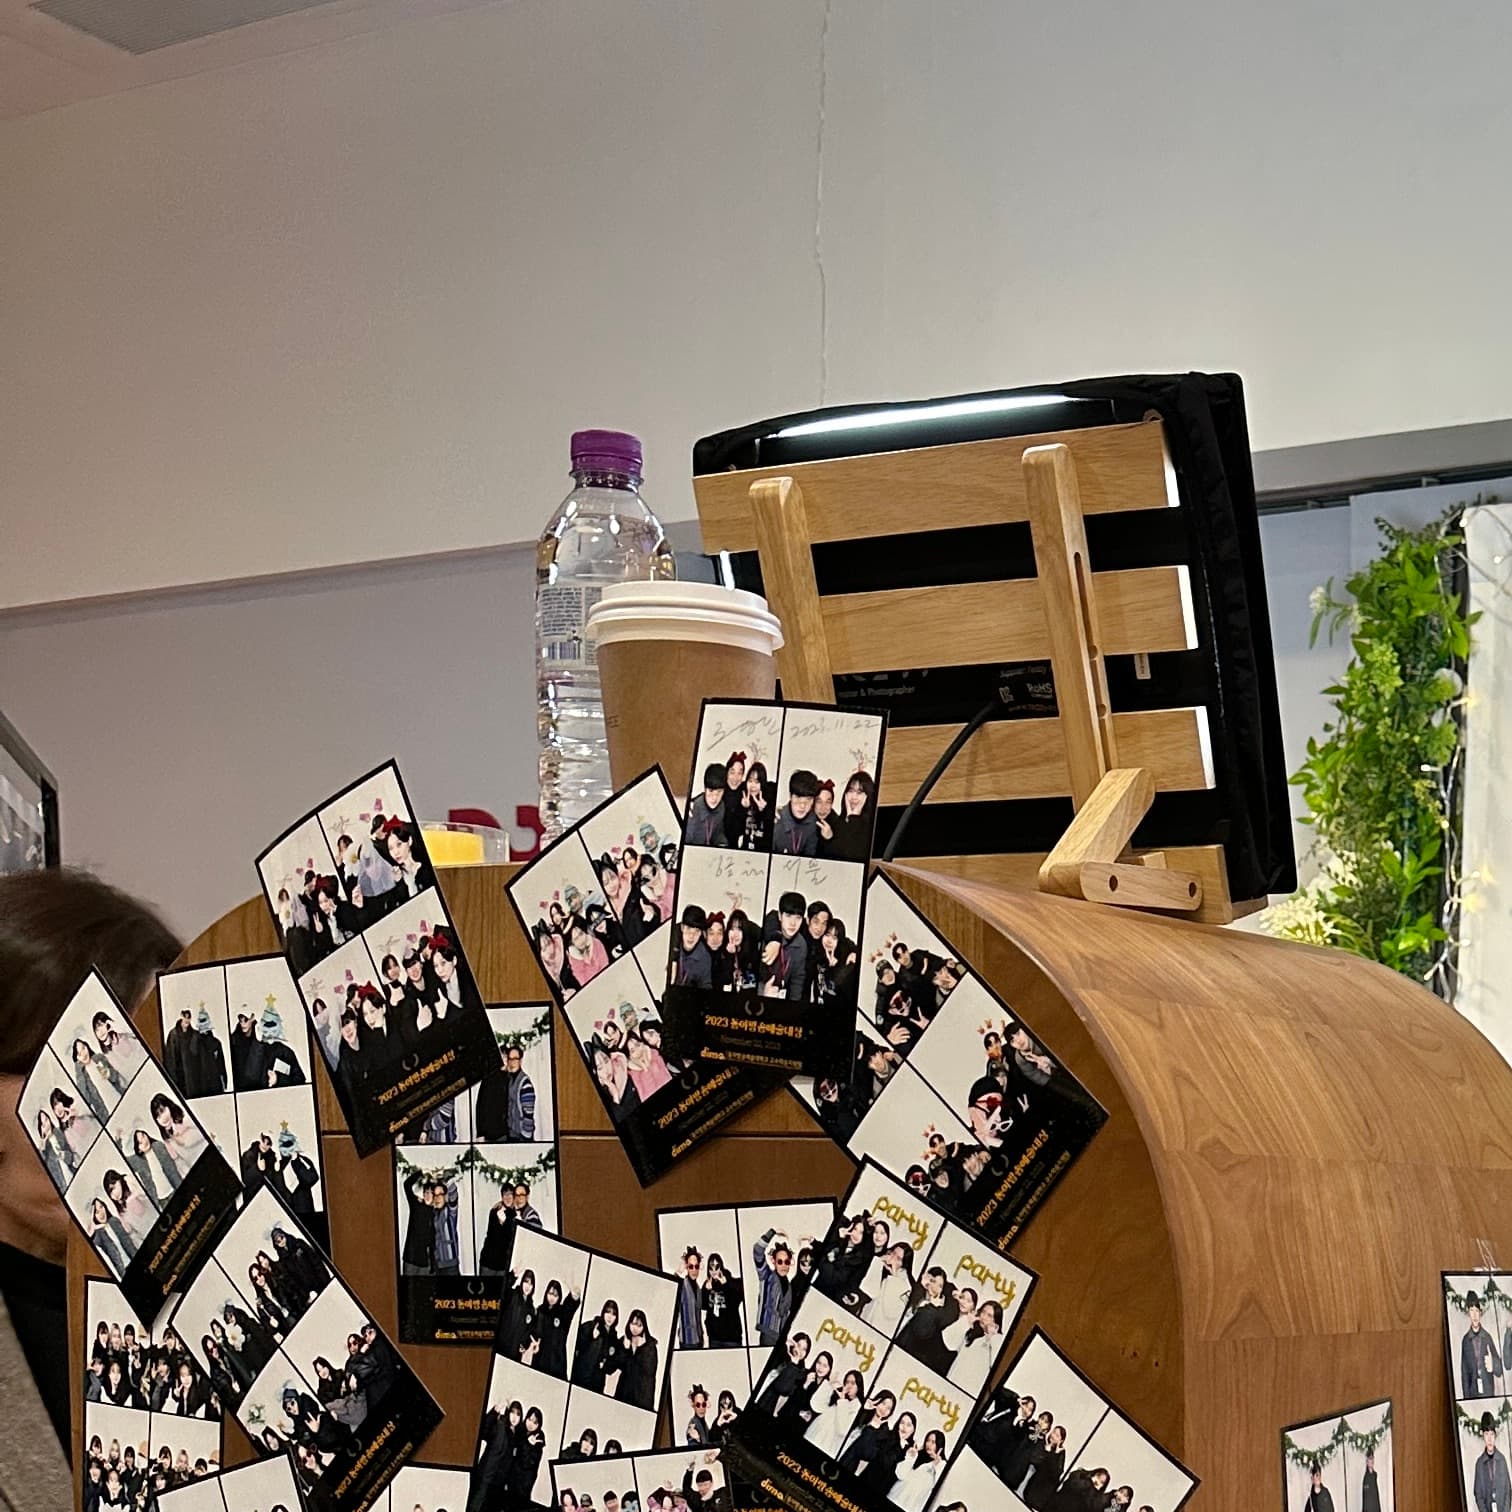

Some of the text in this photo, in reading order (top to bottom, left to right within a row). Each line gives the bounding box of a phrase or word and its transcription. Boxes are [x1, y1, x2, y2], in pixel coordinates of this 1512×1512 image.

[704, 1014, 728, 1027] 2023
[700, 1046, 725, 1060] dima
[656, 1106, 680, 1130] 2023
[871, 1196, 930, 1251] party
[974, 1198, 999, 1227] 2023
[994, 1221, 1021, 1251] dima
[953, 1254, 1016, 1310] party
[434, 1299, 455, 1309] 2023
[815, 1318, 876, 1373] party
[899, 1377, 960, 1432] party
[774, 1450, 803, 1475] 2023
[758, 1475, 787, 1501] dima
